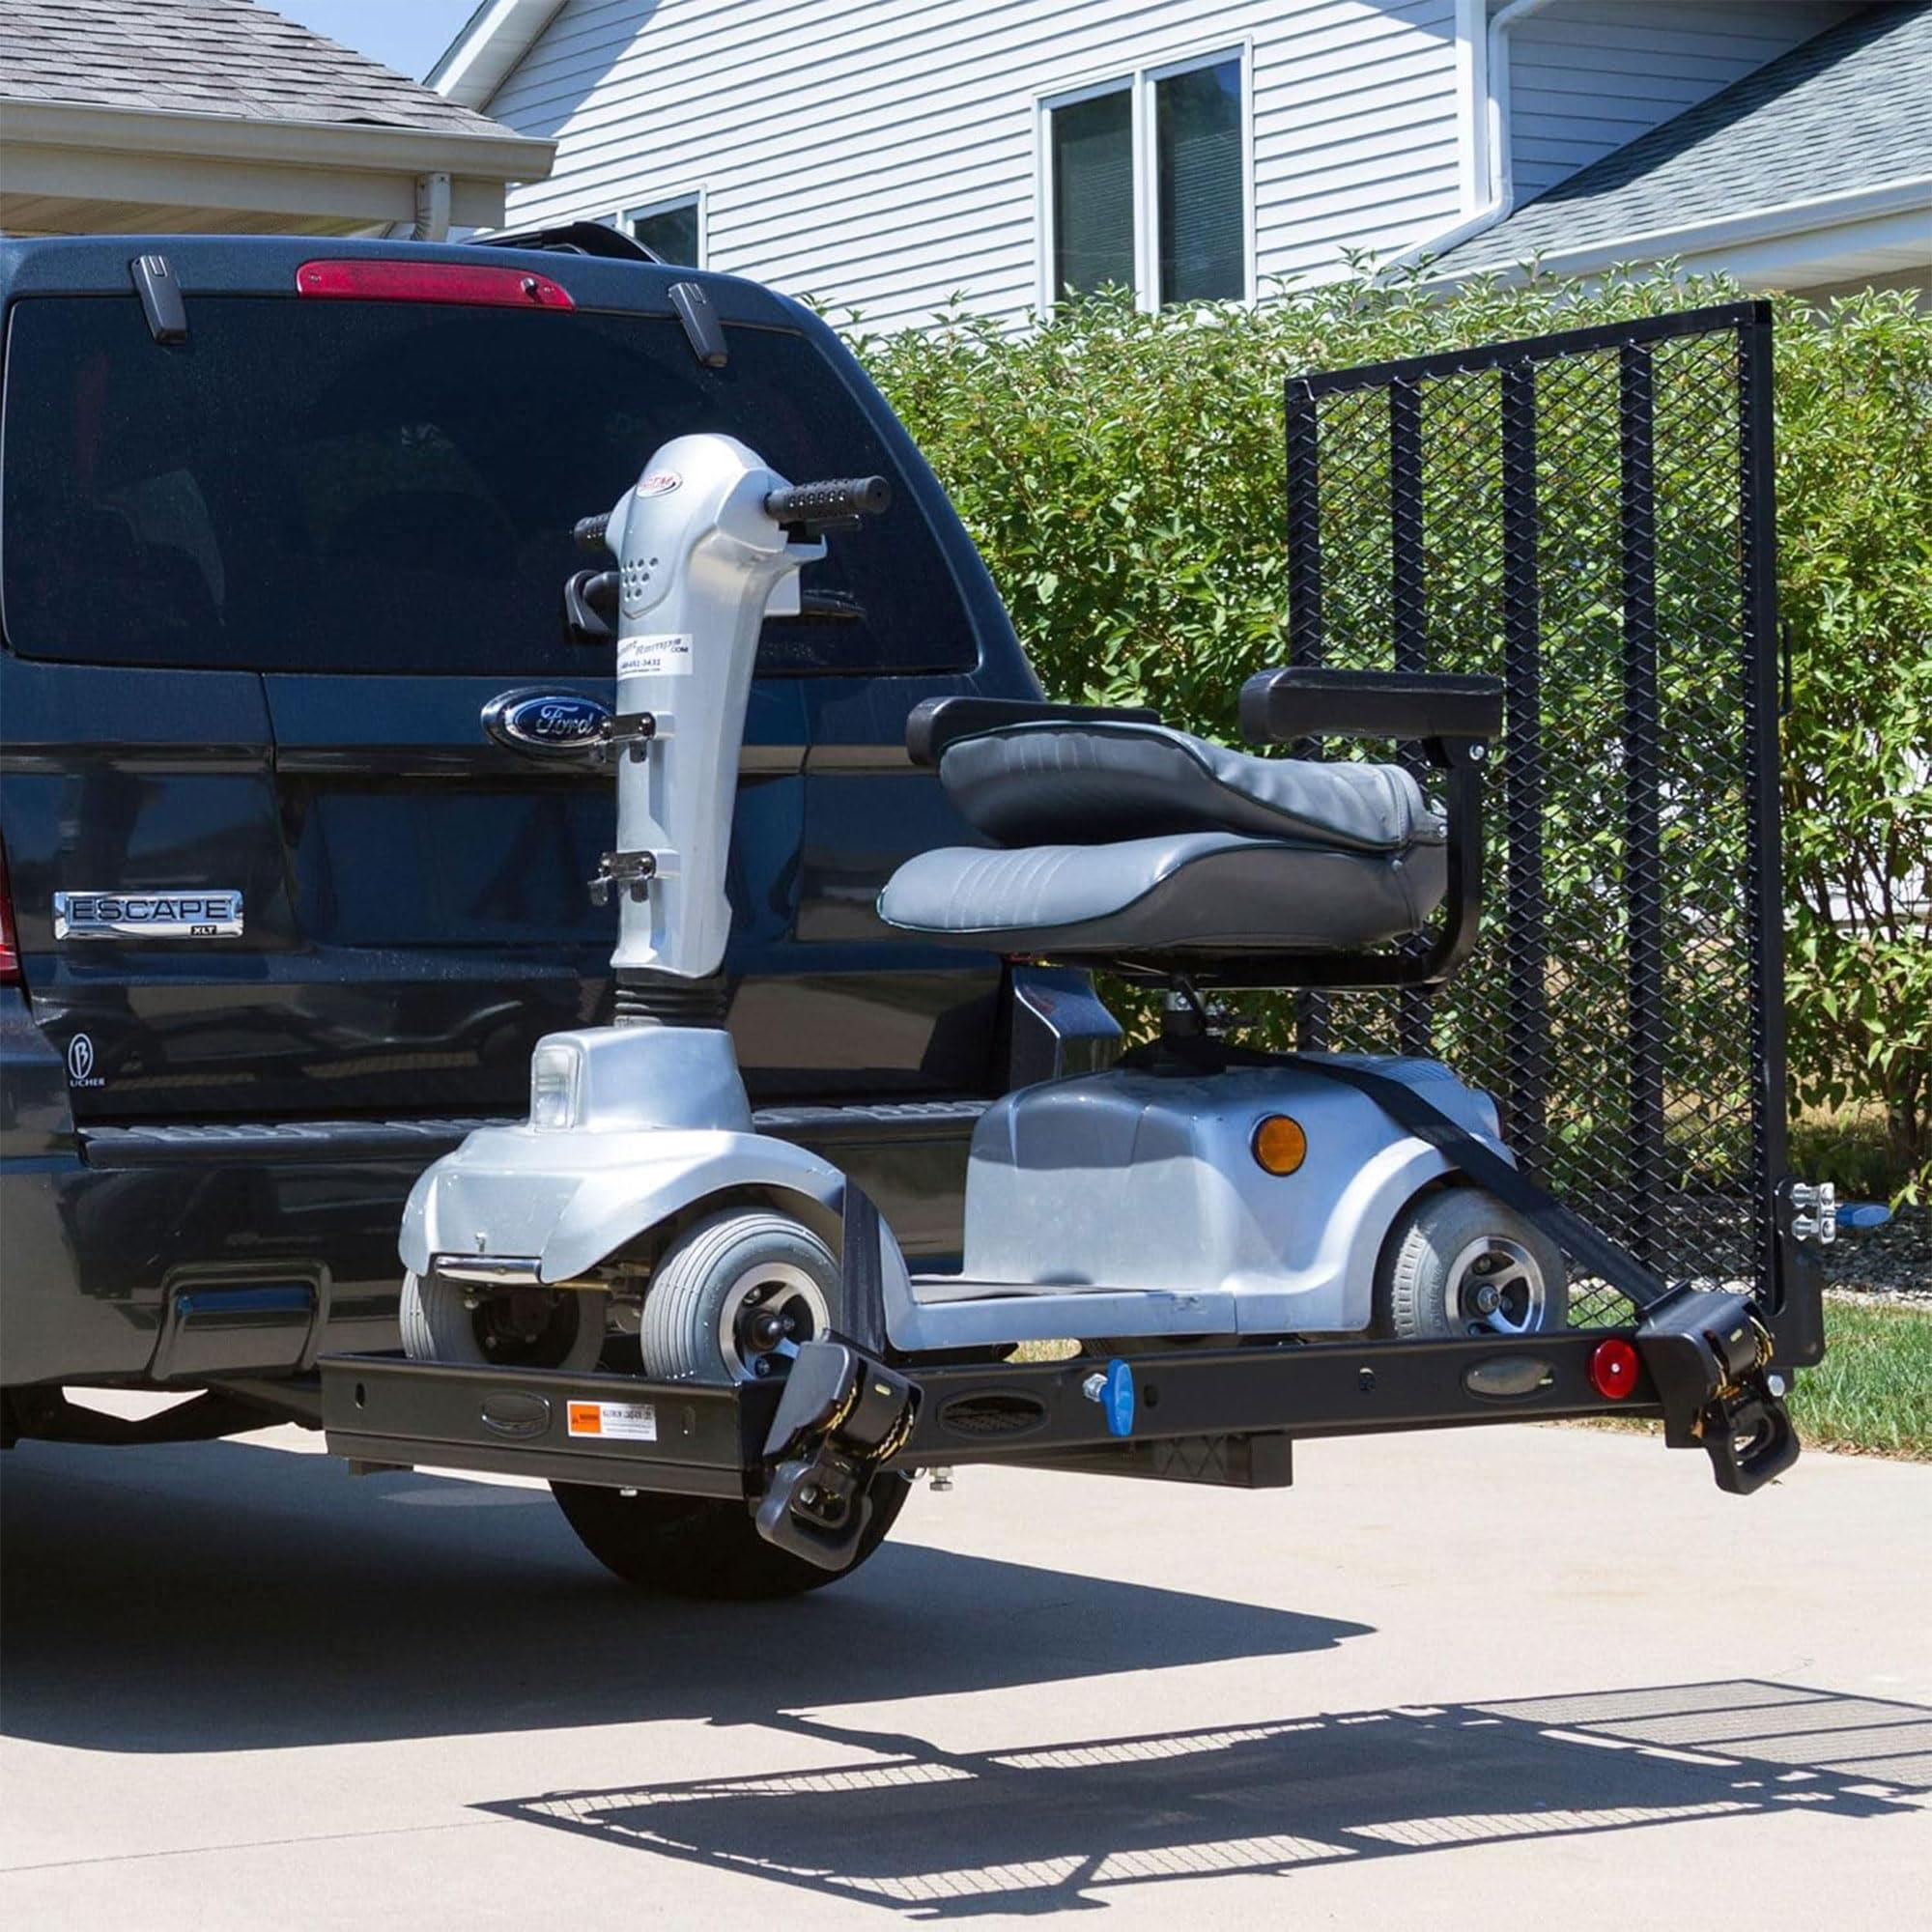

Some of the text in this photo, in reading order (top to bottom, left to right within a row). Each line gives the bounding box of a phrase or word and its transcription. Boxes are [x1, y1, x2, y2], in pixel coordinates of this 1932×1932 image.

[535, 705, 594, 734] Ford
[71, 899, 230, 921] ESCAPE
[192, 924, 216, 935] XLT
